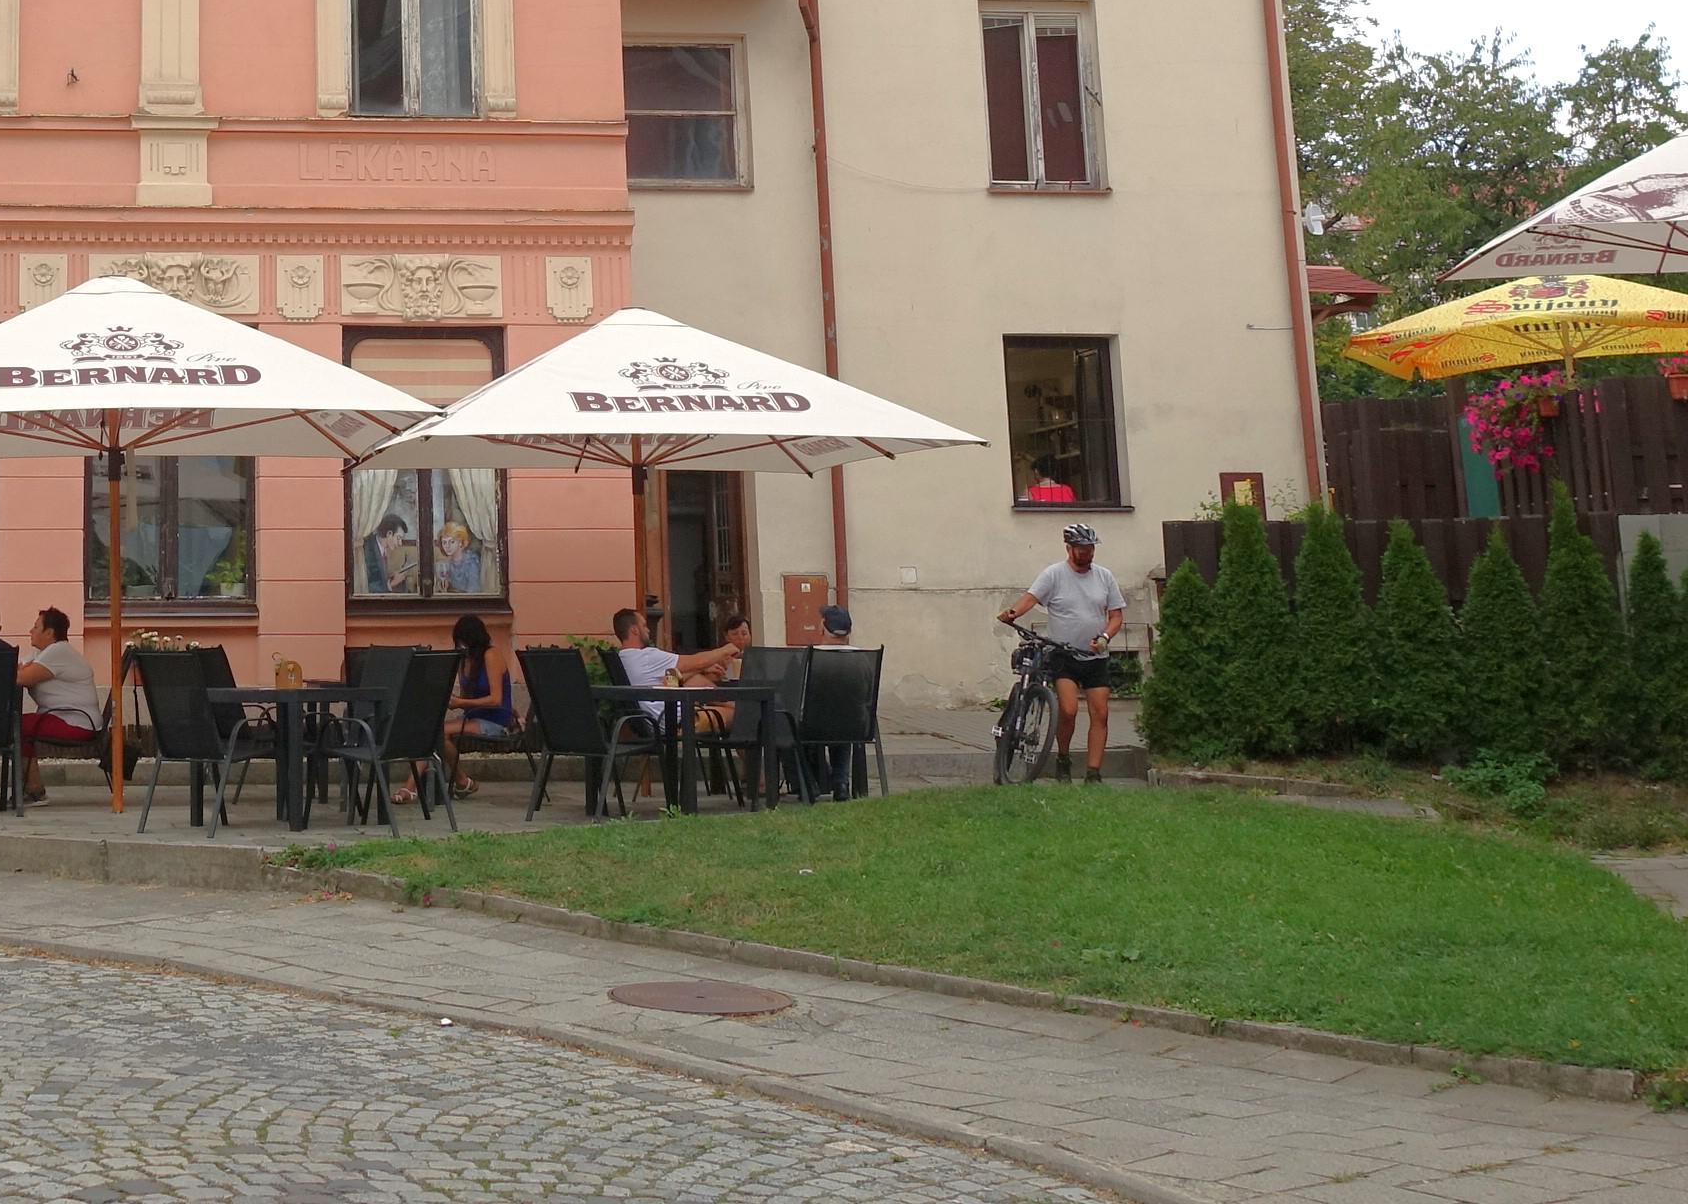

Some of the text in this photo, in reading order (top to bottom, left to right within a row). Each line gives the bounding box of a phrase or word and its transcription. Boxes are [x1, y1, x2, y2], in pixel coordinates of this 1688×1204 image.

[1464, 299, 1618, 316] Svijany
[1645, 309, 1688, 324] Svij
[566, 391, 812, 413] BERNARD
